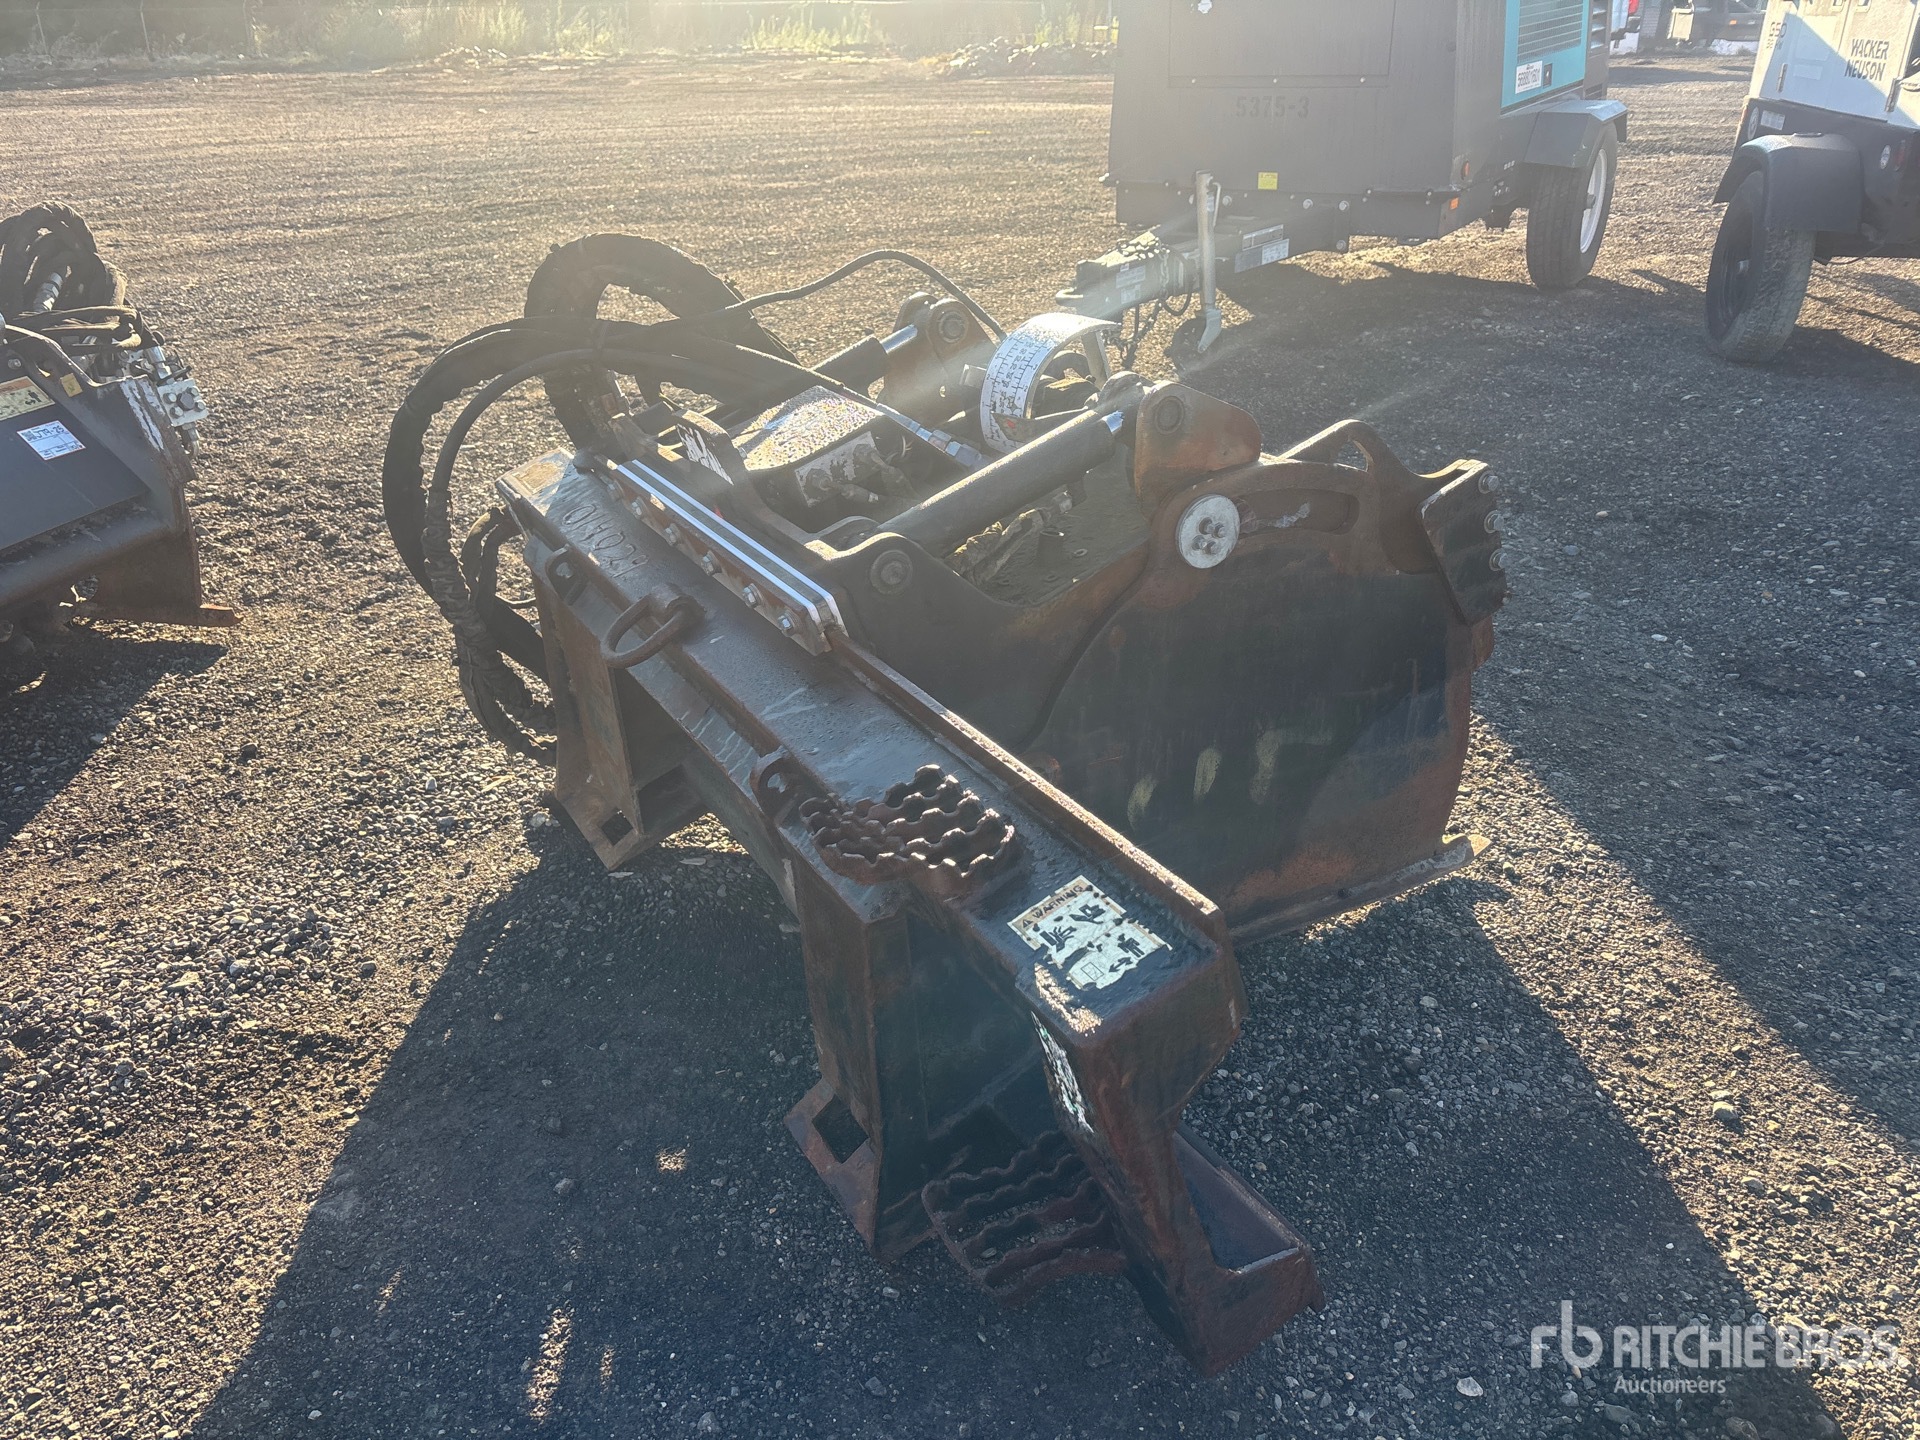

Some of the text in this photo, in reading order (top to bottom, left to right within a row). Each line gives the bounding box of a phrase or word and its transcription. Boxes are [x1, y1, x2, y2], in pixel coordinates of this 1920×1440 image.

[1850, 38, 1889, 60] WACKER
[1845, 59, 1886, 81] NEUSON
[1236, 95, 1309, 118] 5375-3
[1032, 884, 1084, 919] WARNING
